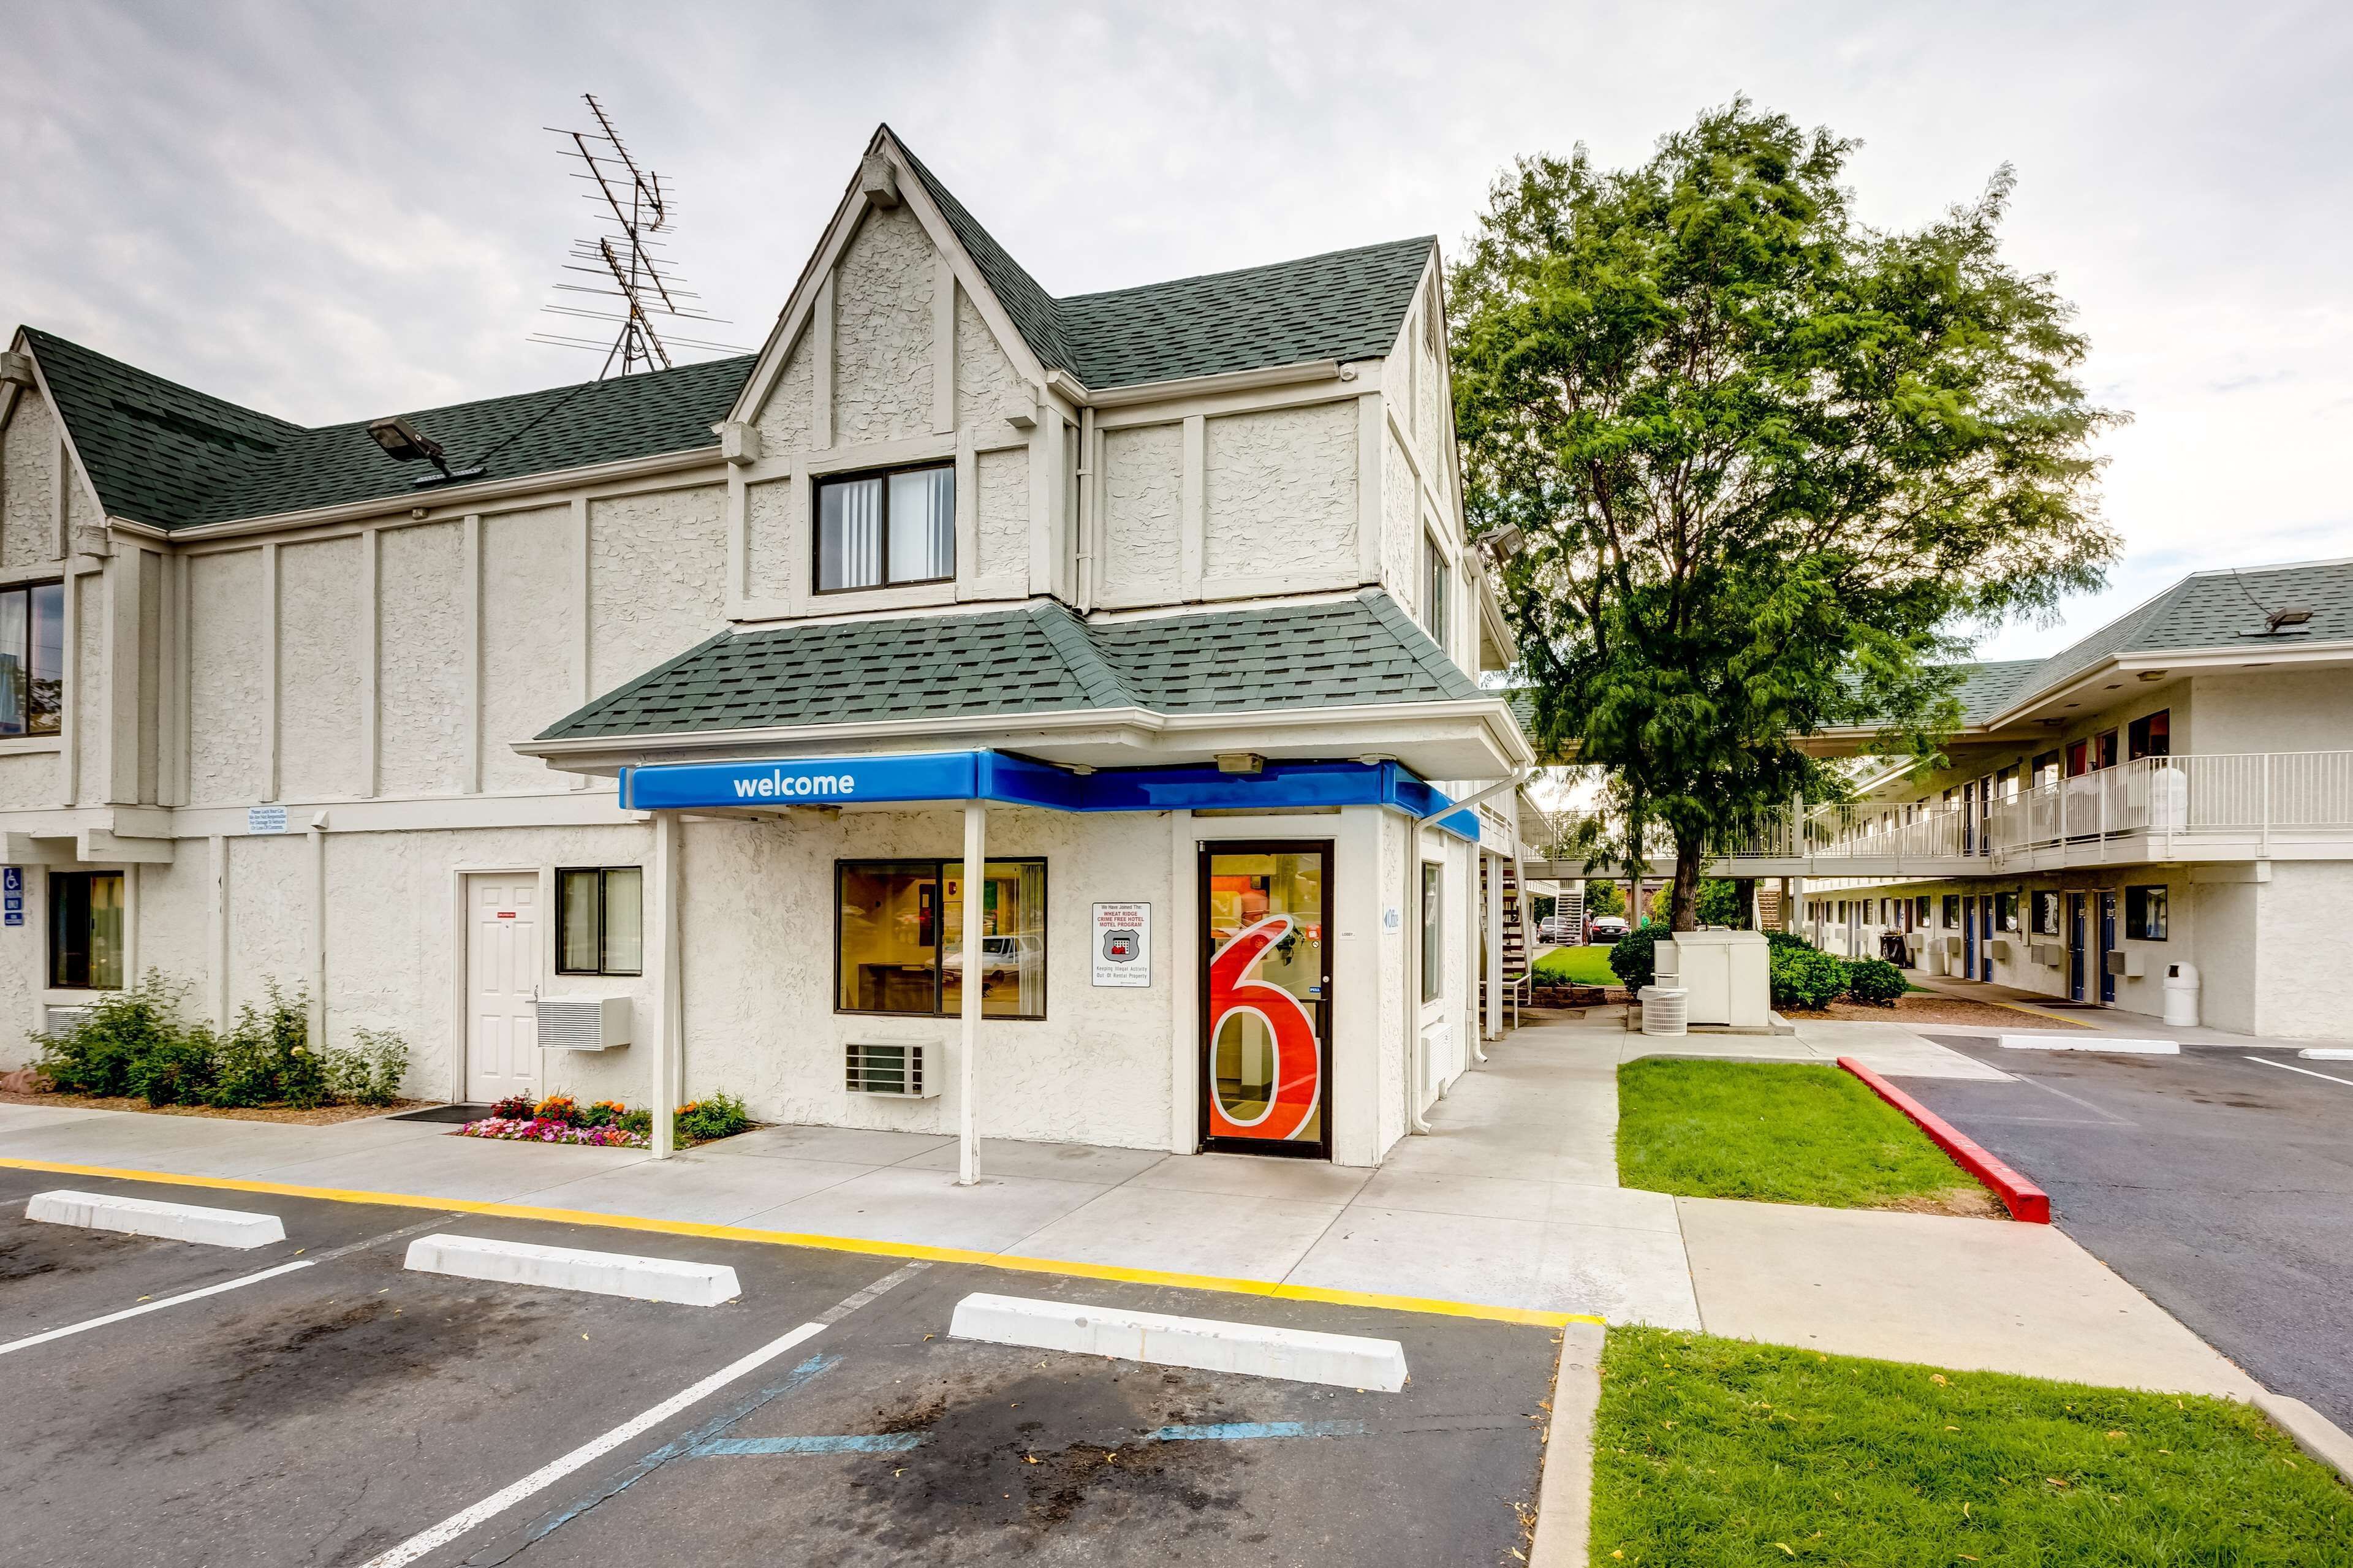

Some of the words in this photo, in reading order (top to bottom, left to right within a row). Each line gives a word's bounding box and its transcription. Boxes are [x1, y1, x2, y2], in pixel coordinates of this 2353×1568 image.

[733, 769, 855, 797] welcome
[1388, 908, 1398, 928] Office
[1210, 914, 1320, 1140] 6
